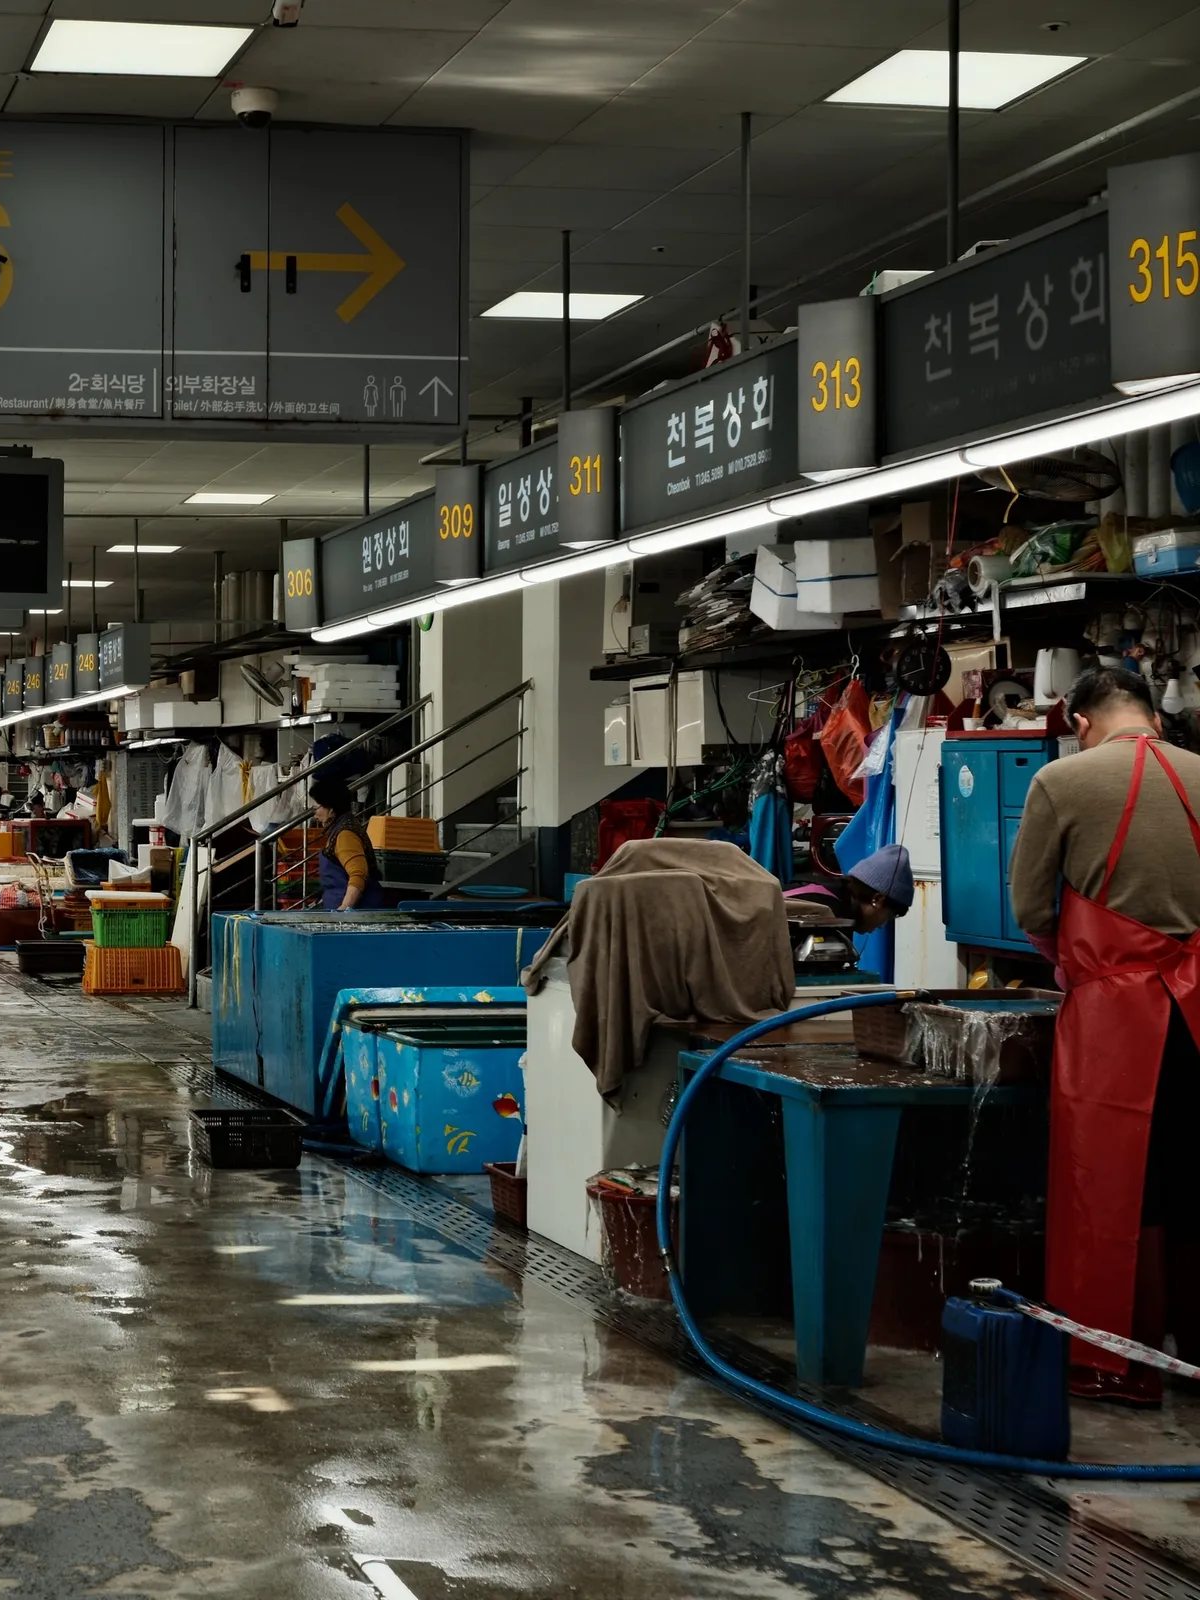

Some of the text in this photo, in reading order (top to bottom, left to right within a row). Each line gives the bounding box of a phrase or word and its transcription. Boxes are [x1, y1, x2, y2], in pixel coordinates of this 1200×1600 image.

[1128, 230, 1200, 304] 315
[924, 252, 1104, 382] 천복상회
[165, 375, 256, 395] 외부화장실
[811, 357, 861, 412] 313
[667, 374, 774, 468] 천복상회
[570, 454, 601, 496] 311
[498, 466, 558, 528] 일성상
[440, 504, 474, 540] 309
[362, 520, 410, 574] 원정상회
[288, 568, 312, 598] 306
[26, 673, 40, 689] 246
[54, 664, 68, 680] 247
[78, 654, 94, 672] 248
[7, 680, 20, 695] 245
